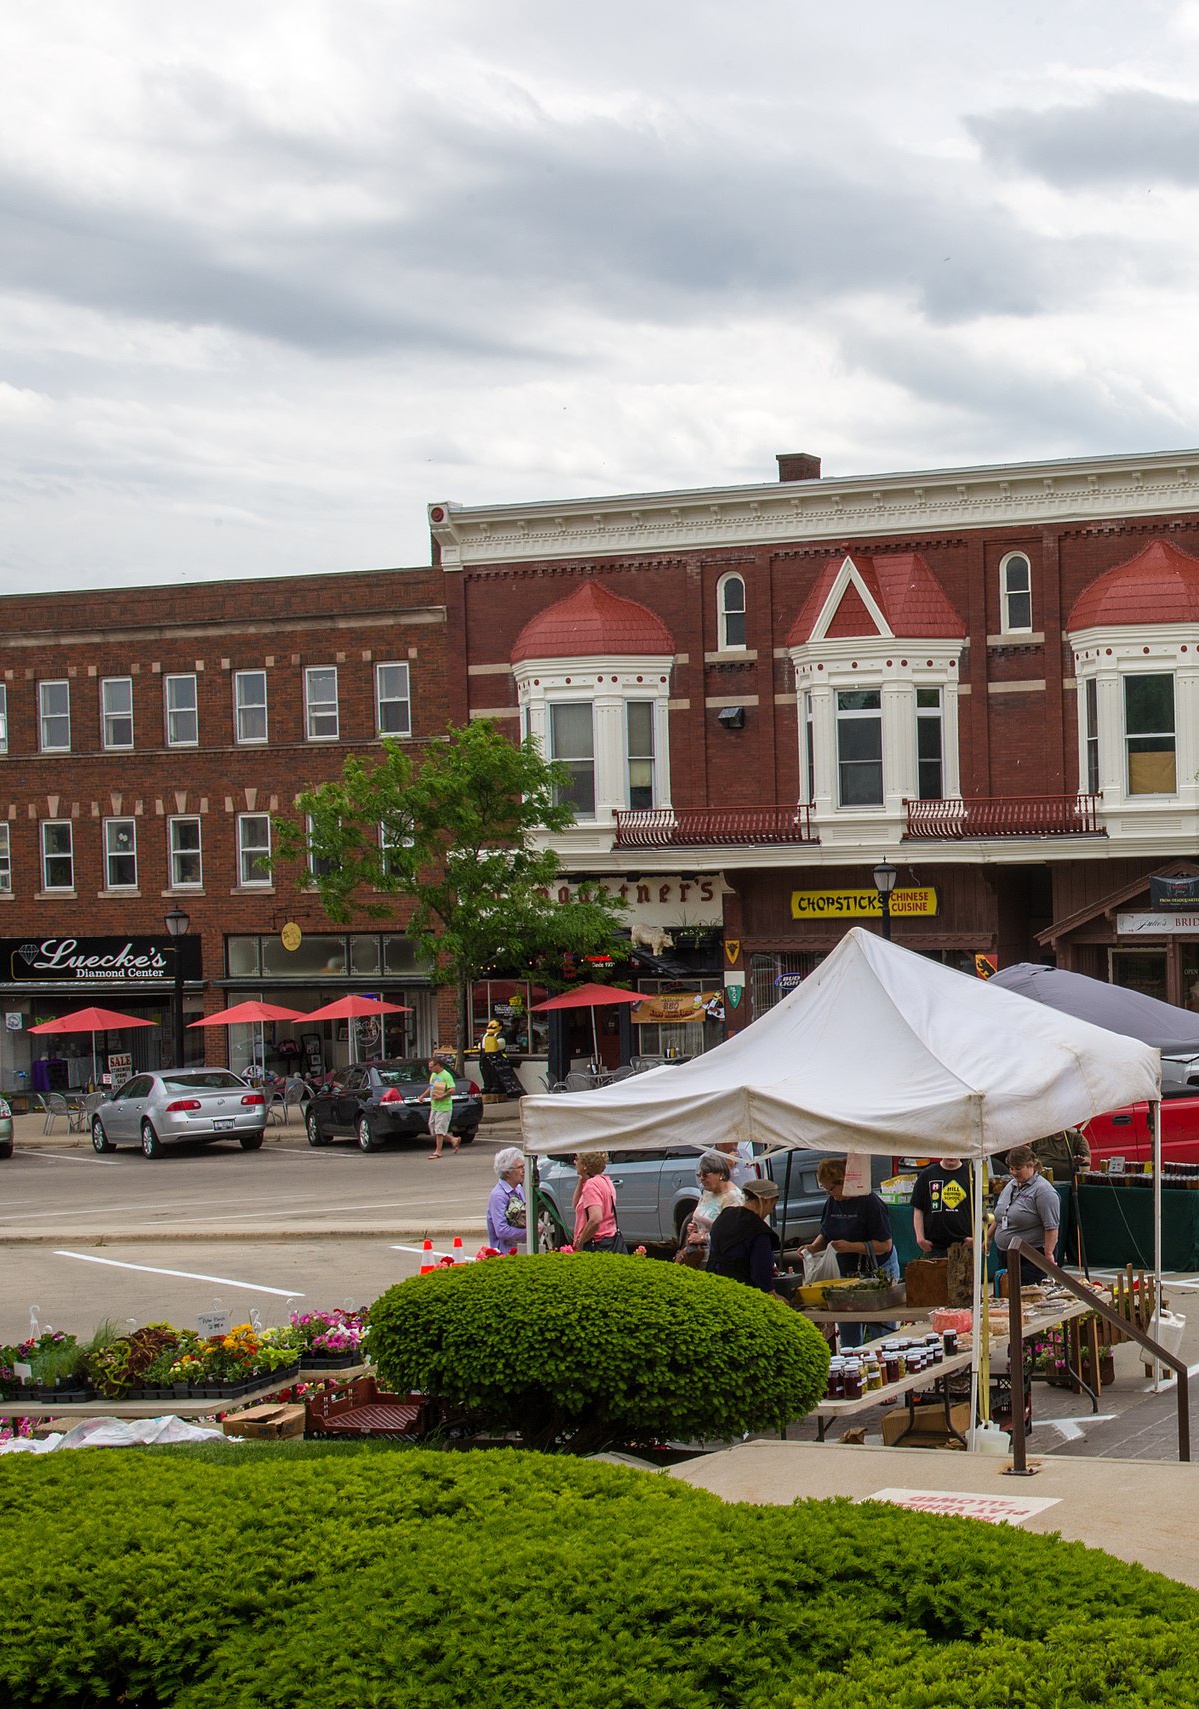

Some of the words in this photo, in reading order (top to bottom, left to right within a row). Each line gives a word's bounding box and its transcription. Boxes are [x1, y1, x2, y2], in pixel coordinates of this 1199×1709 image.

[890, 892, 929, 902] CHINESE
[798, 894, 885, 912] CHOPSTICKS
[891, 902, 928, 912] CUISINE
[33, 939, 167, 969] Luecke's
[76, 968, 126, 978] Diamond
[127, 968, 164, 977] Center
[110, 1056, 131, 1067] SALE
[908, 1495, 1017, 1507] ALLOWED
[970, 1504, 1031, 1516] PLAY
